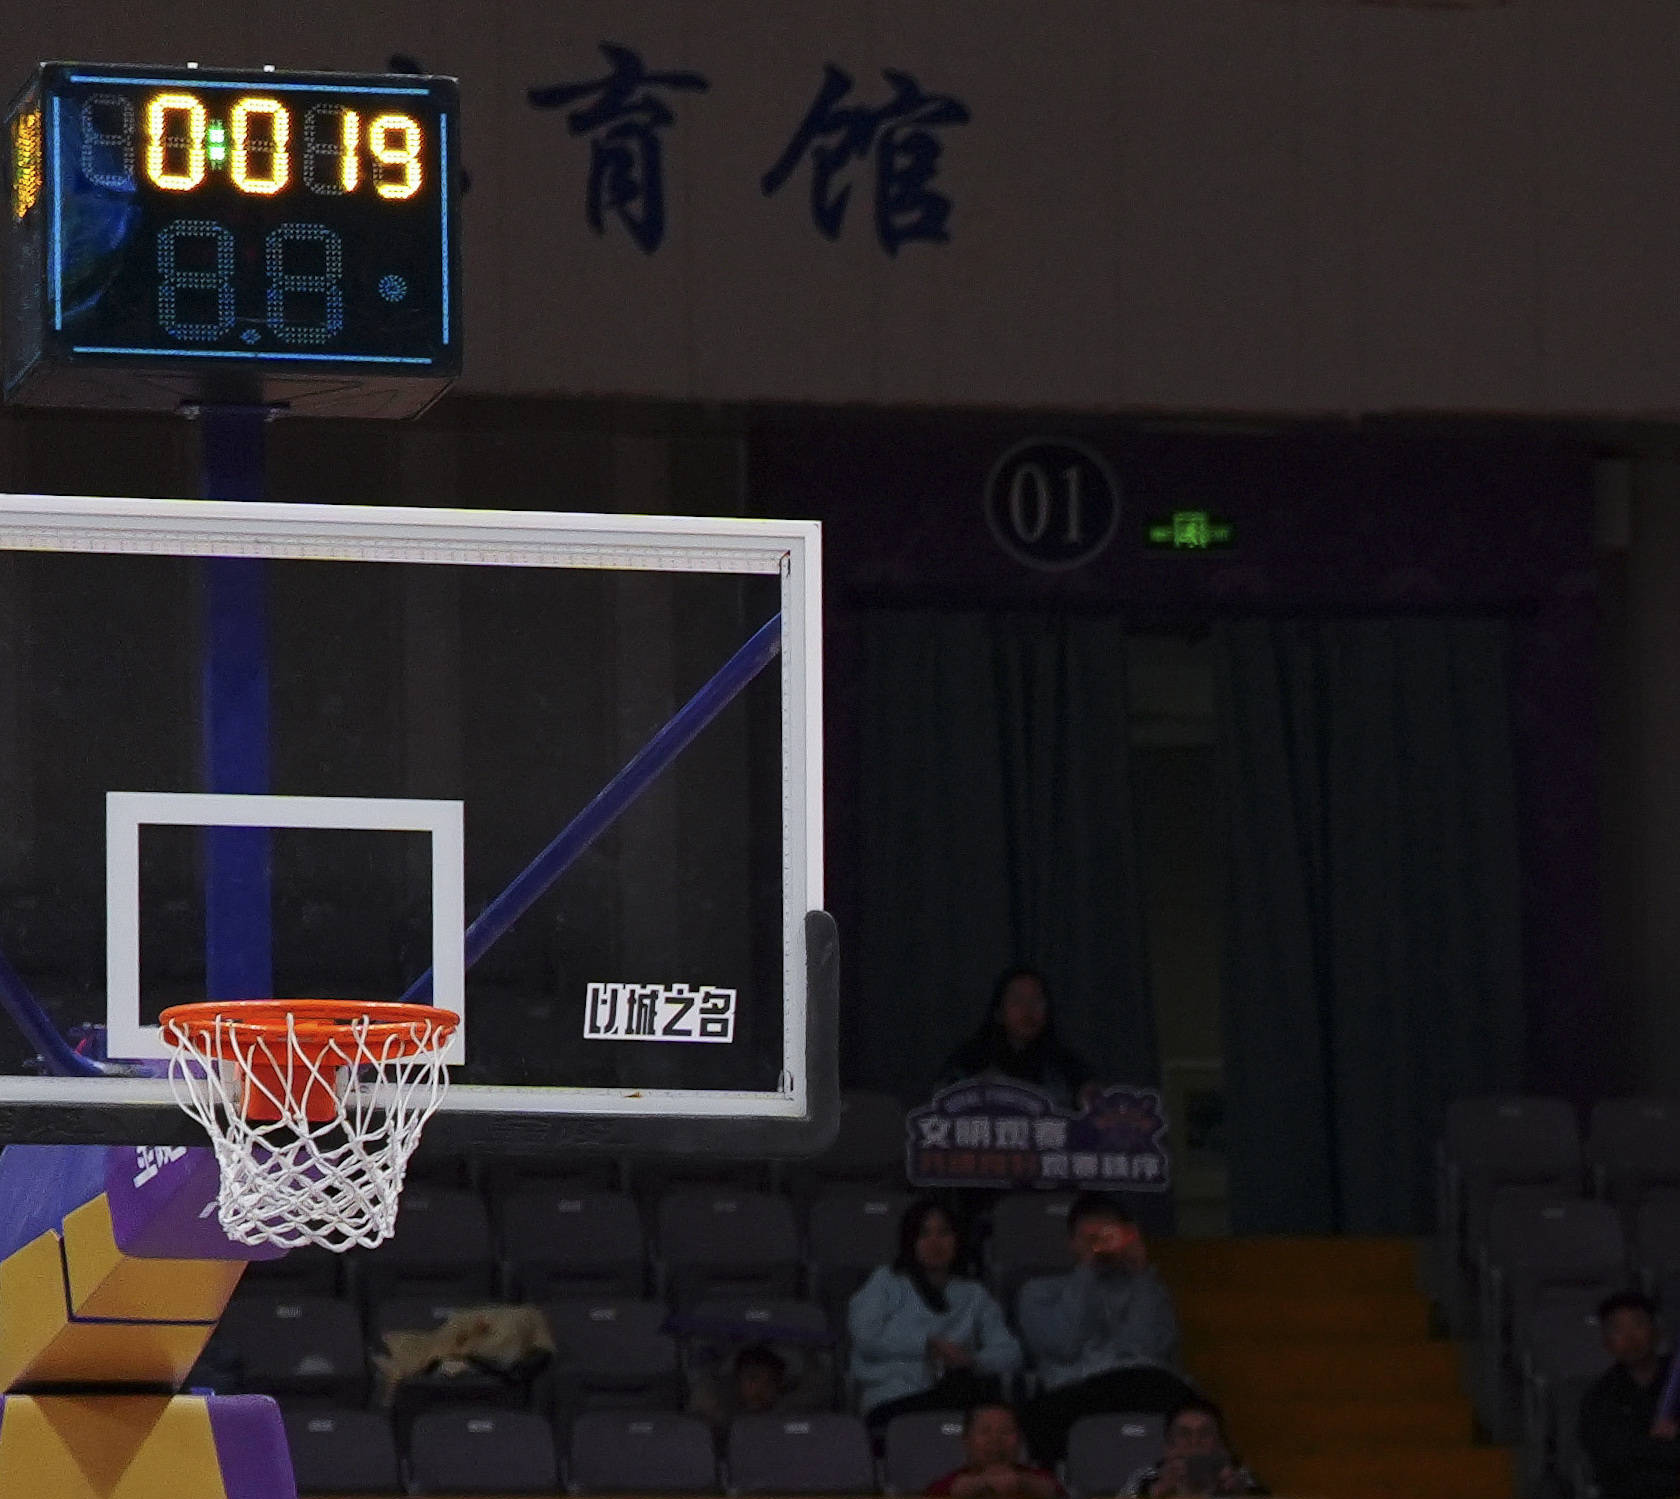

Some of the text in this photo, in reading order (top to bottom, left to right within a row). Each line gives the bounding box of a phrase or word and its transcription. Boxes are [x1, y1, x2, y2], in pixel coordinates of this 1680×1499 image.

[390, 41, 972, 258] 育馆
[1008, 462, 1086, 544] 01
[585, 984, 735, 1042] 以城之名
